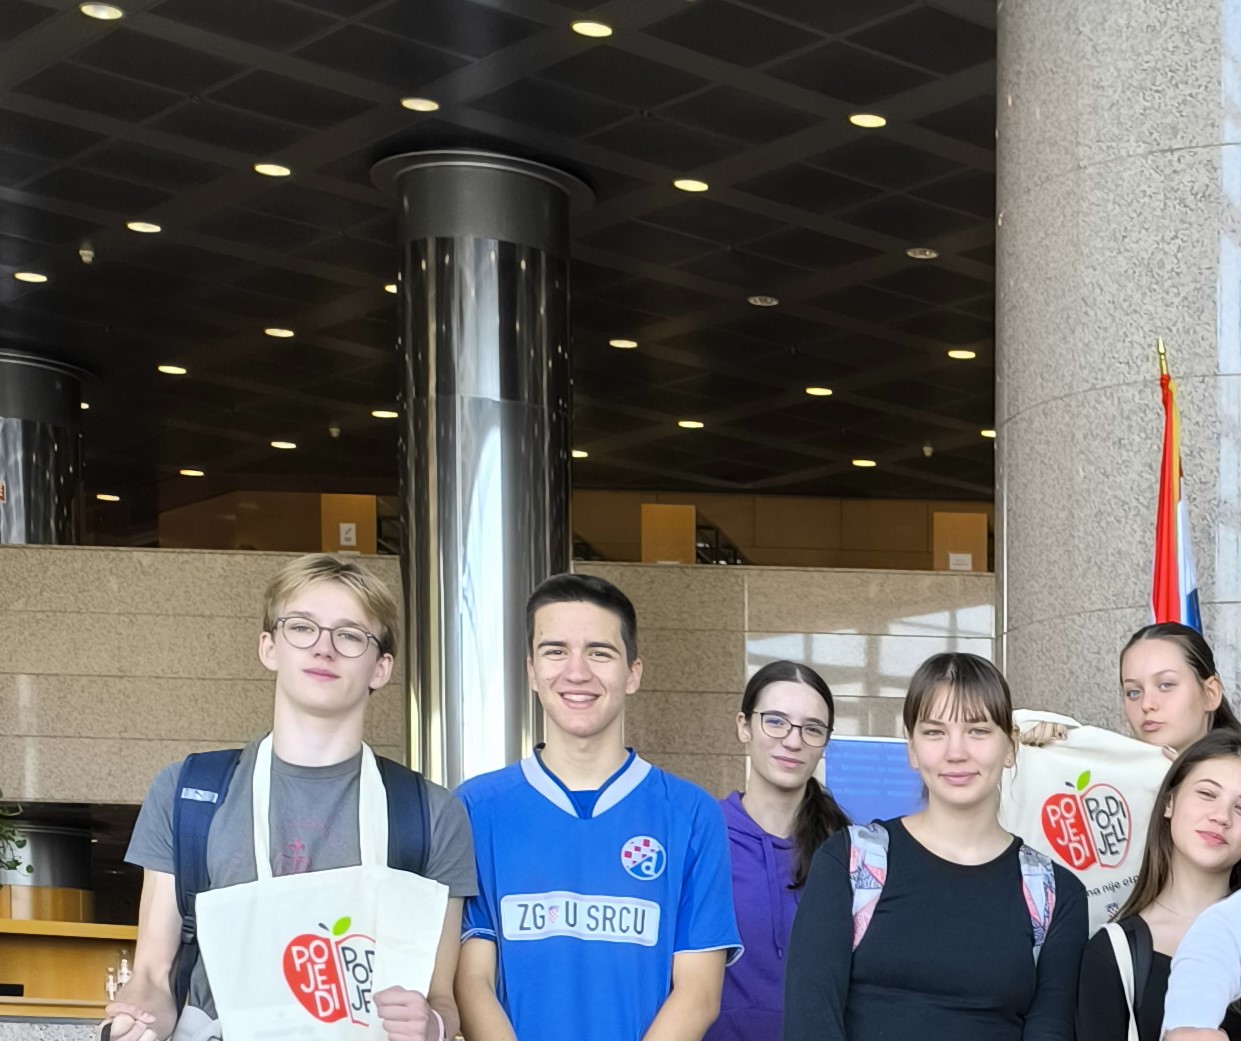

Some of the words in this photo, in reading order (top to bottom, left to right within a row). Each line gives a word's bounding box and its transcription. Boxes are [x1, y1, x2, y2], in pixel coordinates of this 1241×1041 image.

[517, 903, 546, 931] ZG
[565, 901, 578, 928] U
[586, 905, 646, 935] SRCU
